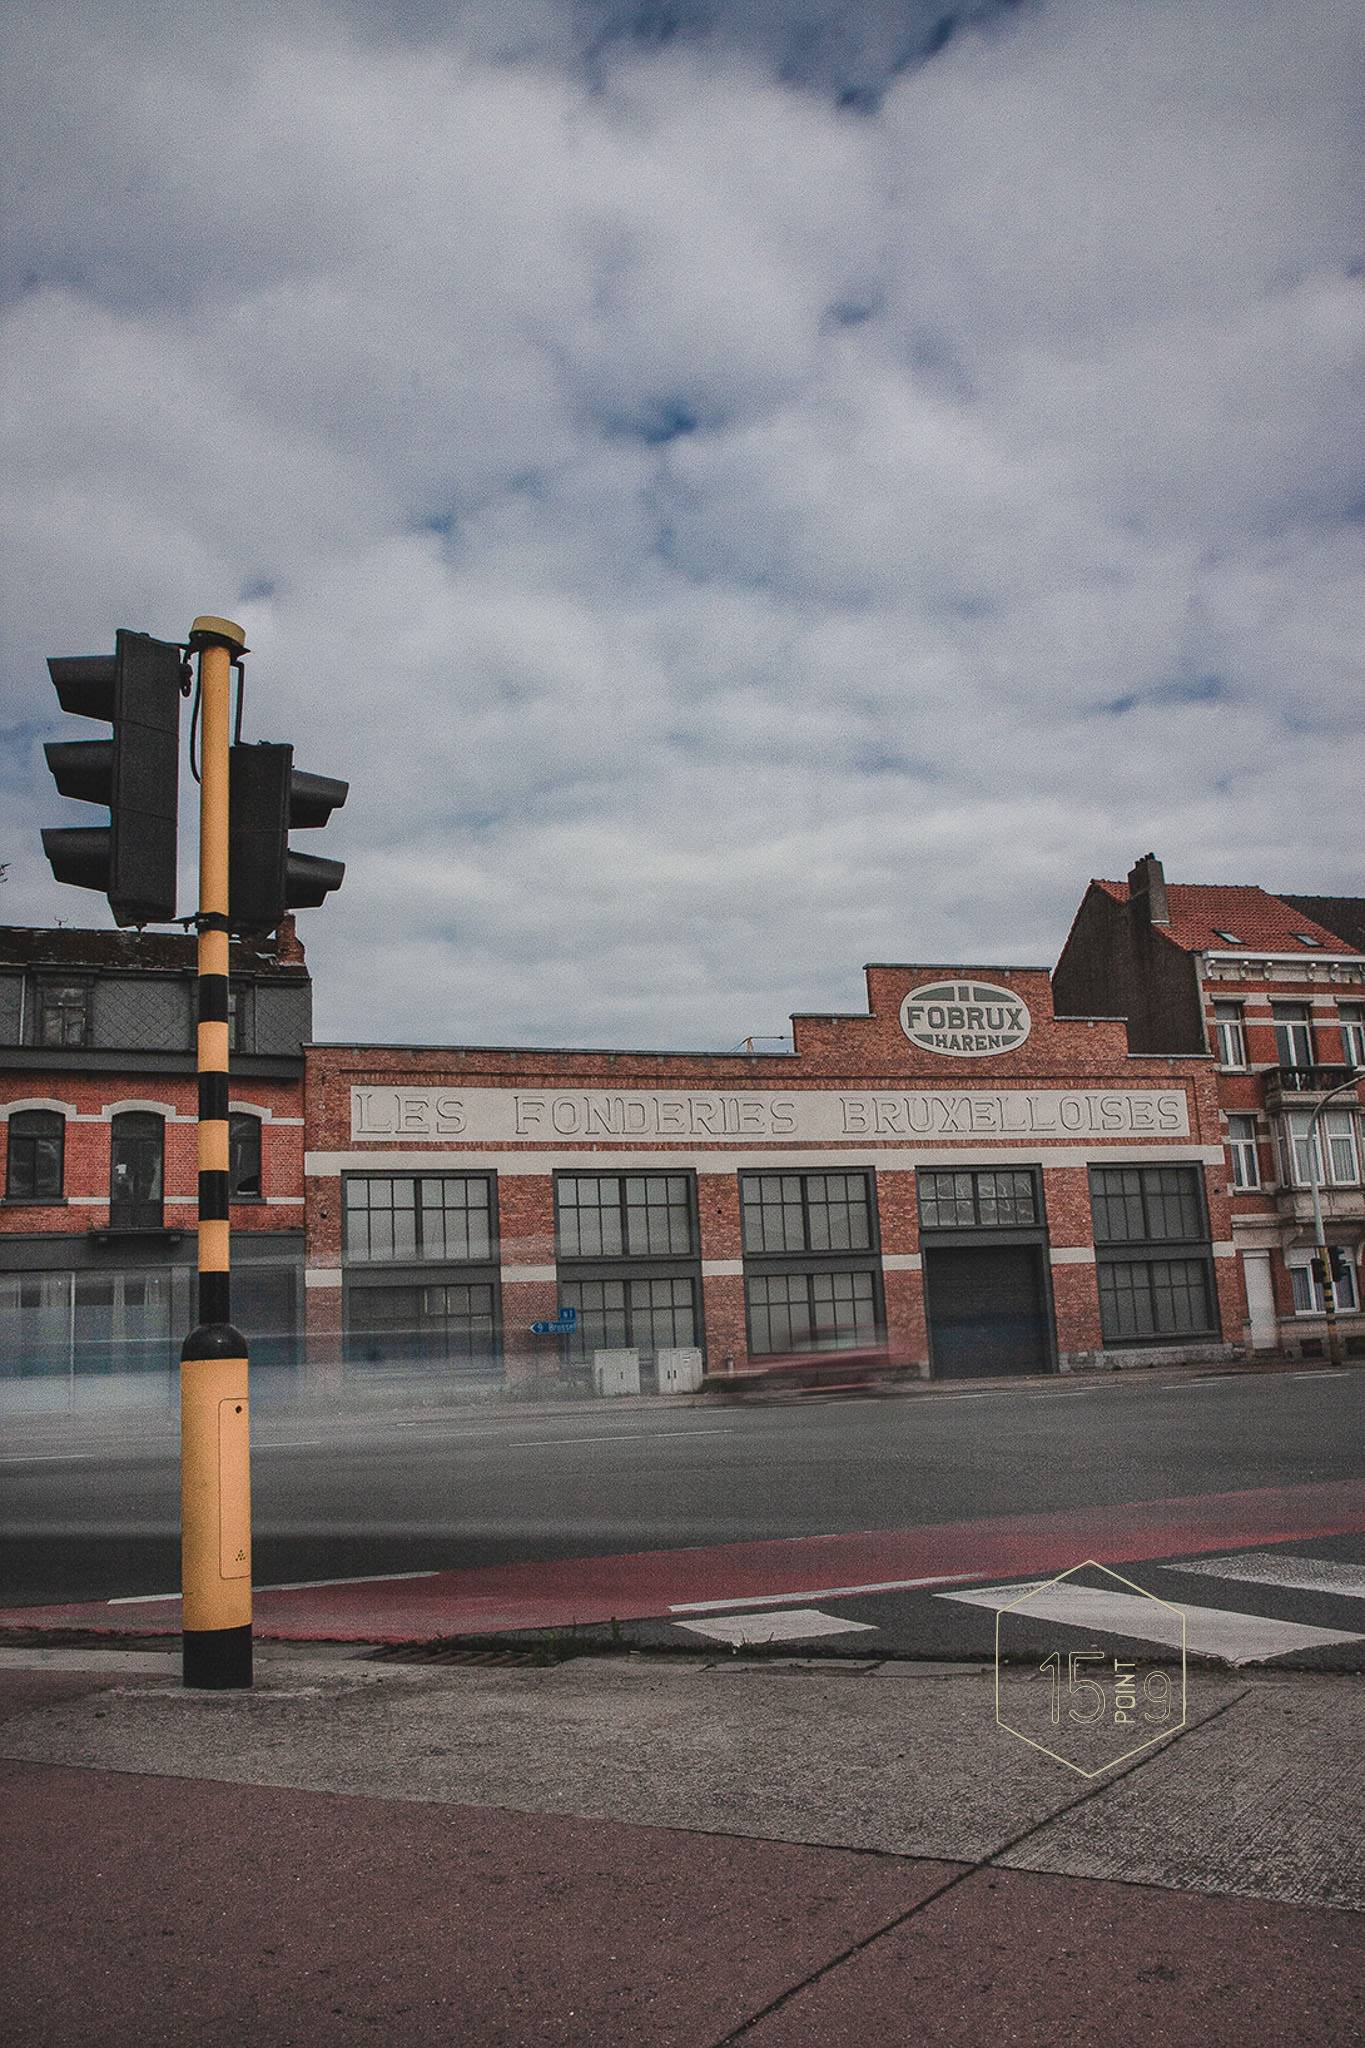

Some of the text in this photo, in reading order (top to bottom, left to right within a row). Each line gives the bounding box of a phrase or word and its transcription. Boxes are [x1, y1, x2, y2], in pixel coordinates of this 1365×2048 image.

[906, 1006, 1025, 1031] FOBRUX
[933, 1034, 1003, 1051] HAREN
[356, 1093, 1183, 1135] LES FONDERIES BRUXELLOISES
